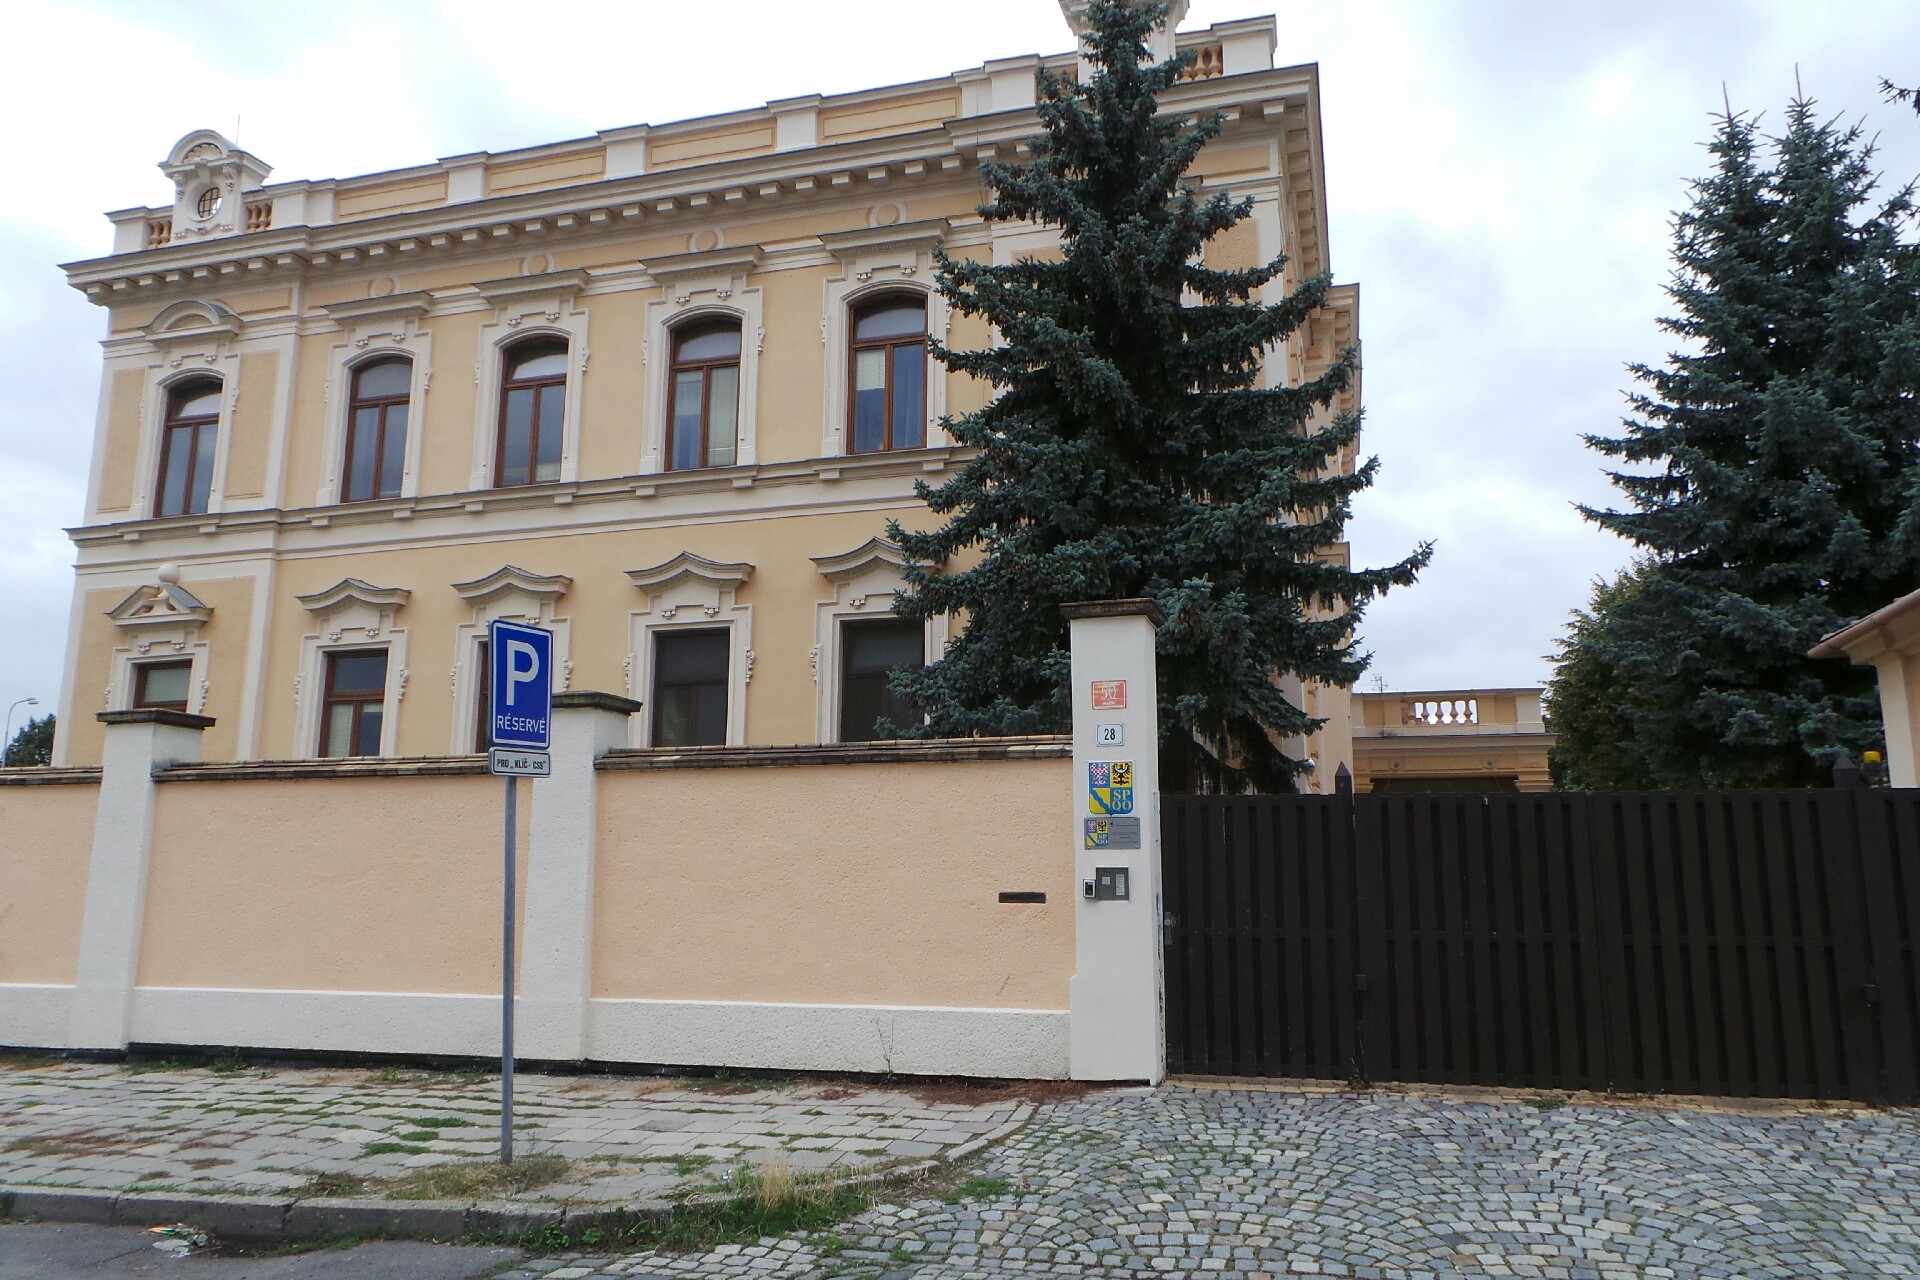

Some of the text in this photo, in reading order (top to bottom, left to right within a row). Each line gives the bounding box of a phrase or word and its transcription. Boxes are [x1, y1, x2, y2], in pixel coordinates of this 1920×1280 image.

[506, 639, 540, 706] P
[496, 713, 546, 734] RÉSERVÉ
[1104, 728, 1116, 741] 28
[496, 758, 509, 768] PRO
[1113, 789, 1131, 801] SP
[1111, 800, 1132, 812] QO
